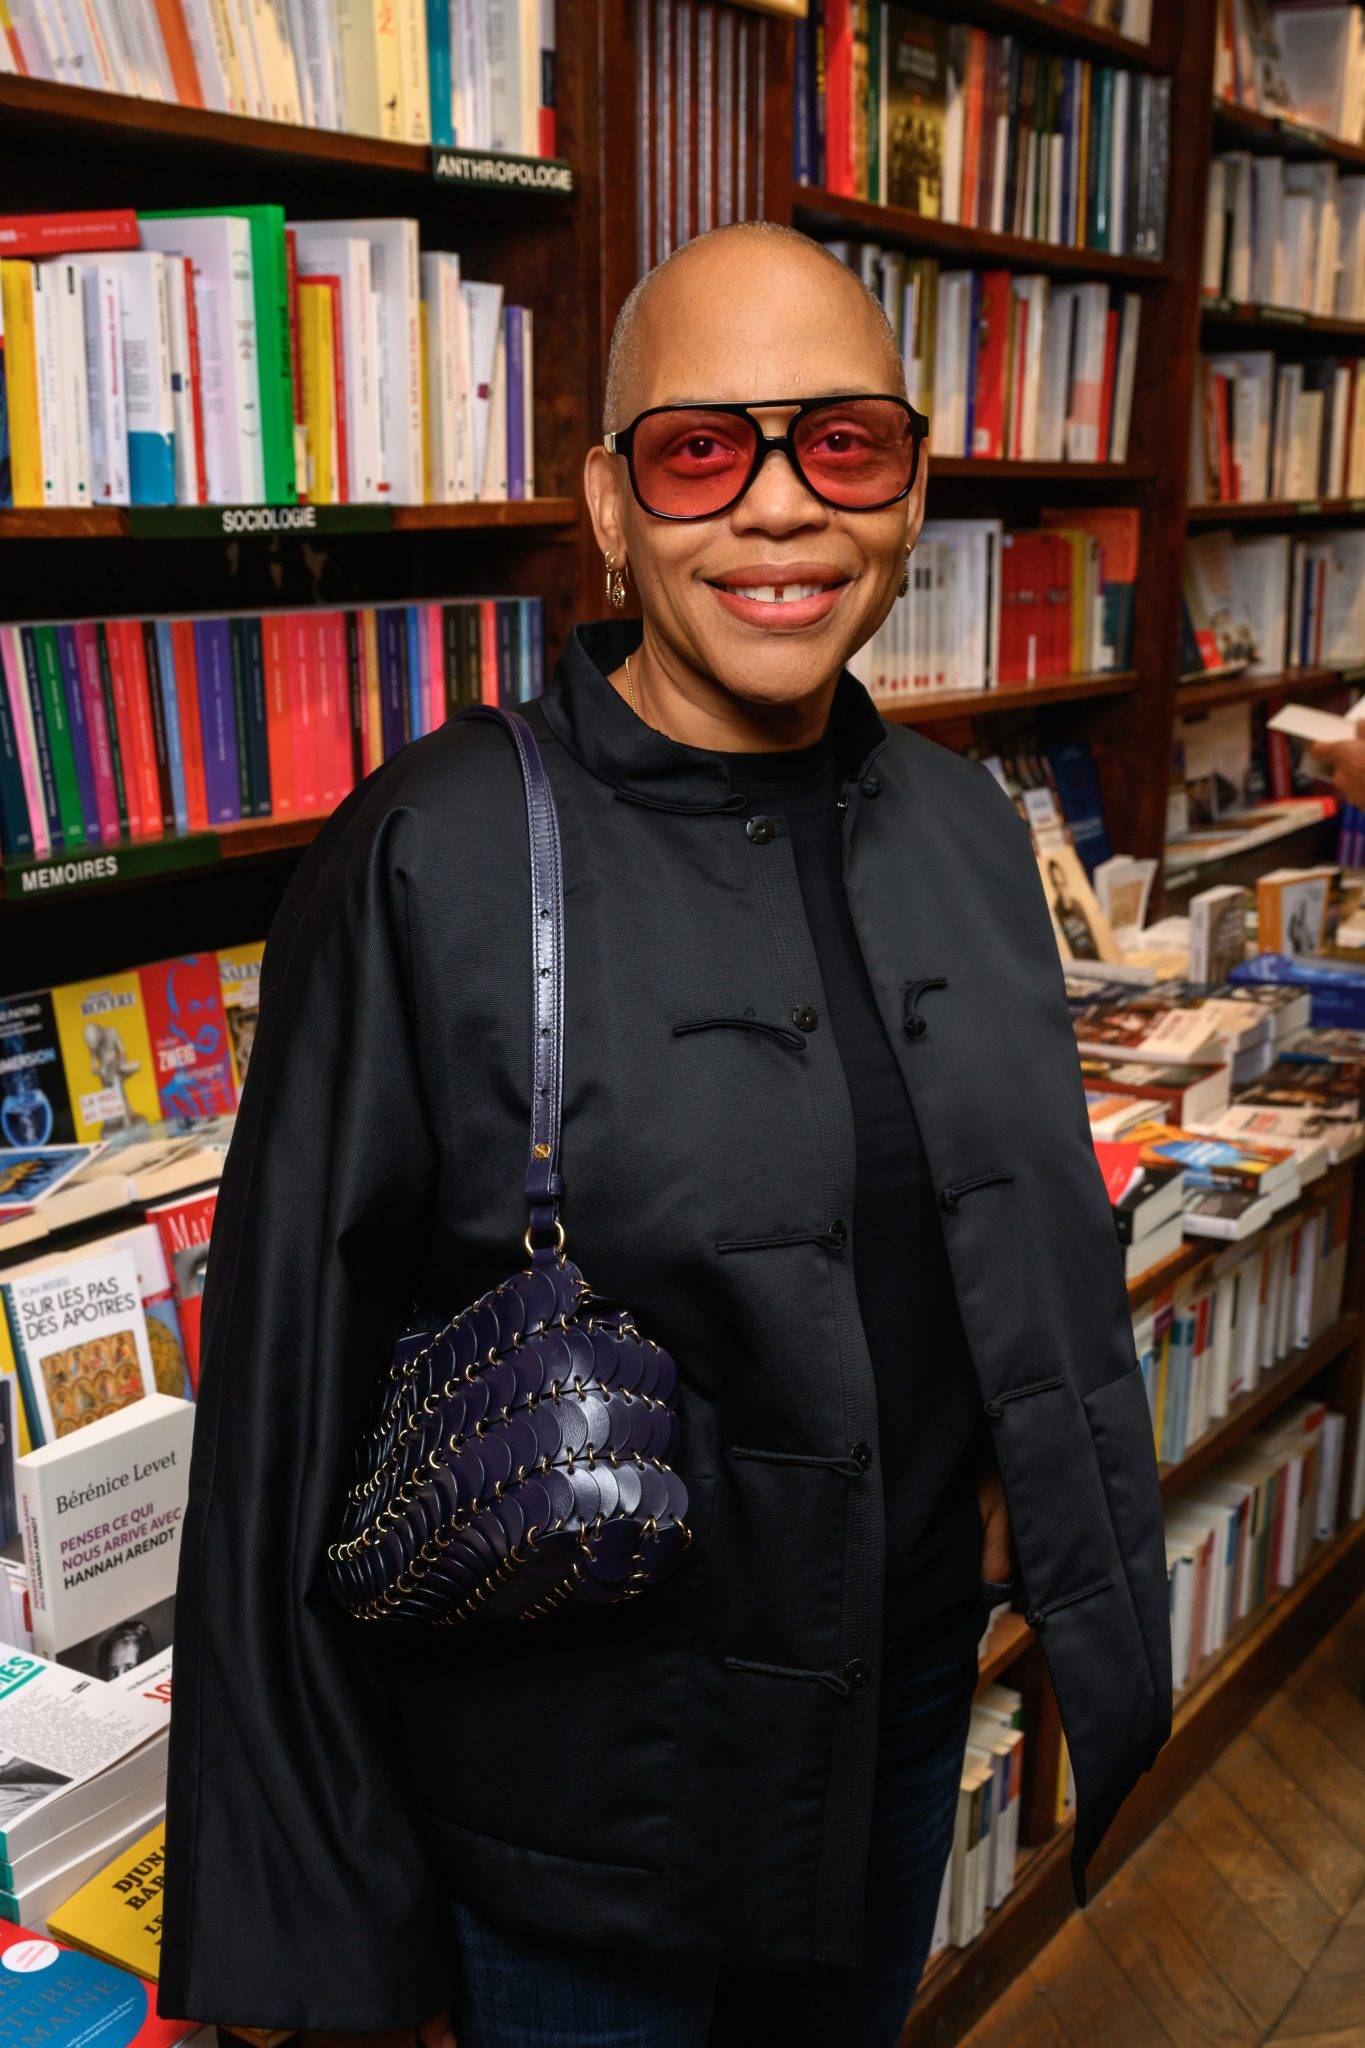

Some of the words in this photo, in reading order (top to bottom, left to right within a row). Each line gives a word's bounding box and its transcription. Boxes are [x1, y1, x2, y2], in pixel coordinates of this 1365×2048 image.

[436, 154, 572, 192] ANTHROPOLOGIE
[222, 506, 316, 532] SOCIOLOGIE
[22, 855, 118, 892] MEMOIRES
[22, 1296, 55, 1320] SUR
[57, 1286, 84, 1309] LES
[87, 1277, 119, 1299] PAS
[26, 1316, 58, 1341] DES
[55, 1474, 130, 1515] Bérénice
[133, 1450, 177, 1482] Levet
[60, 1523, 110, 1554] PENSER
[112, 1514, 128, 1531] CE
[130, 1503, 154, 1523] QUI
[62, 1546, 101, 1572] NOUS
[103, 1525, 148, 1554] ARRIVE
[150, 1508, 182, 1532] AVEC
[64, 1553, 123, 1590] HANNAH
[125, 1527, 175, 1562] ARENDT
